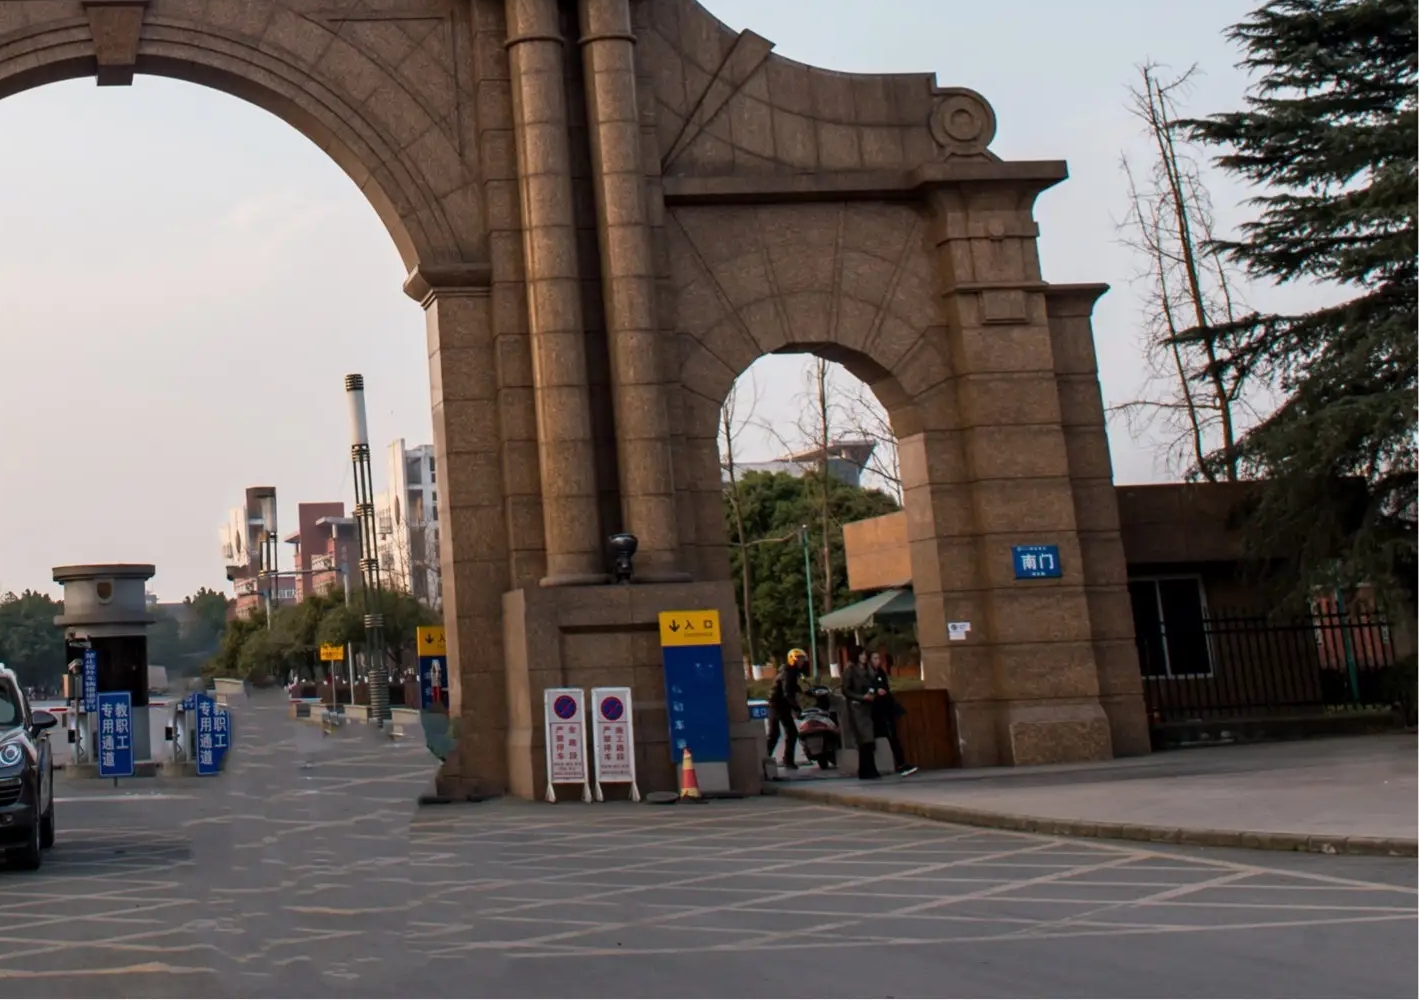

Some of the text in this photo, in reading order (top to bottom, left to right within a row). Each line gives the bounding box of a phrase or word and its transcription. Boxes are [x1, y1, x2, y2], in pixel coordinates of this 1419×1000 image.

[1021, 553, 1055, 570] 南门
[684, 619, 713, 630] 入口
[101, 703, 115, 767] 专用通道
[115, 703, 129, 749] 教职工
[199, 701, 213, 765] 专用通道
